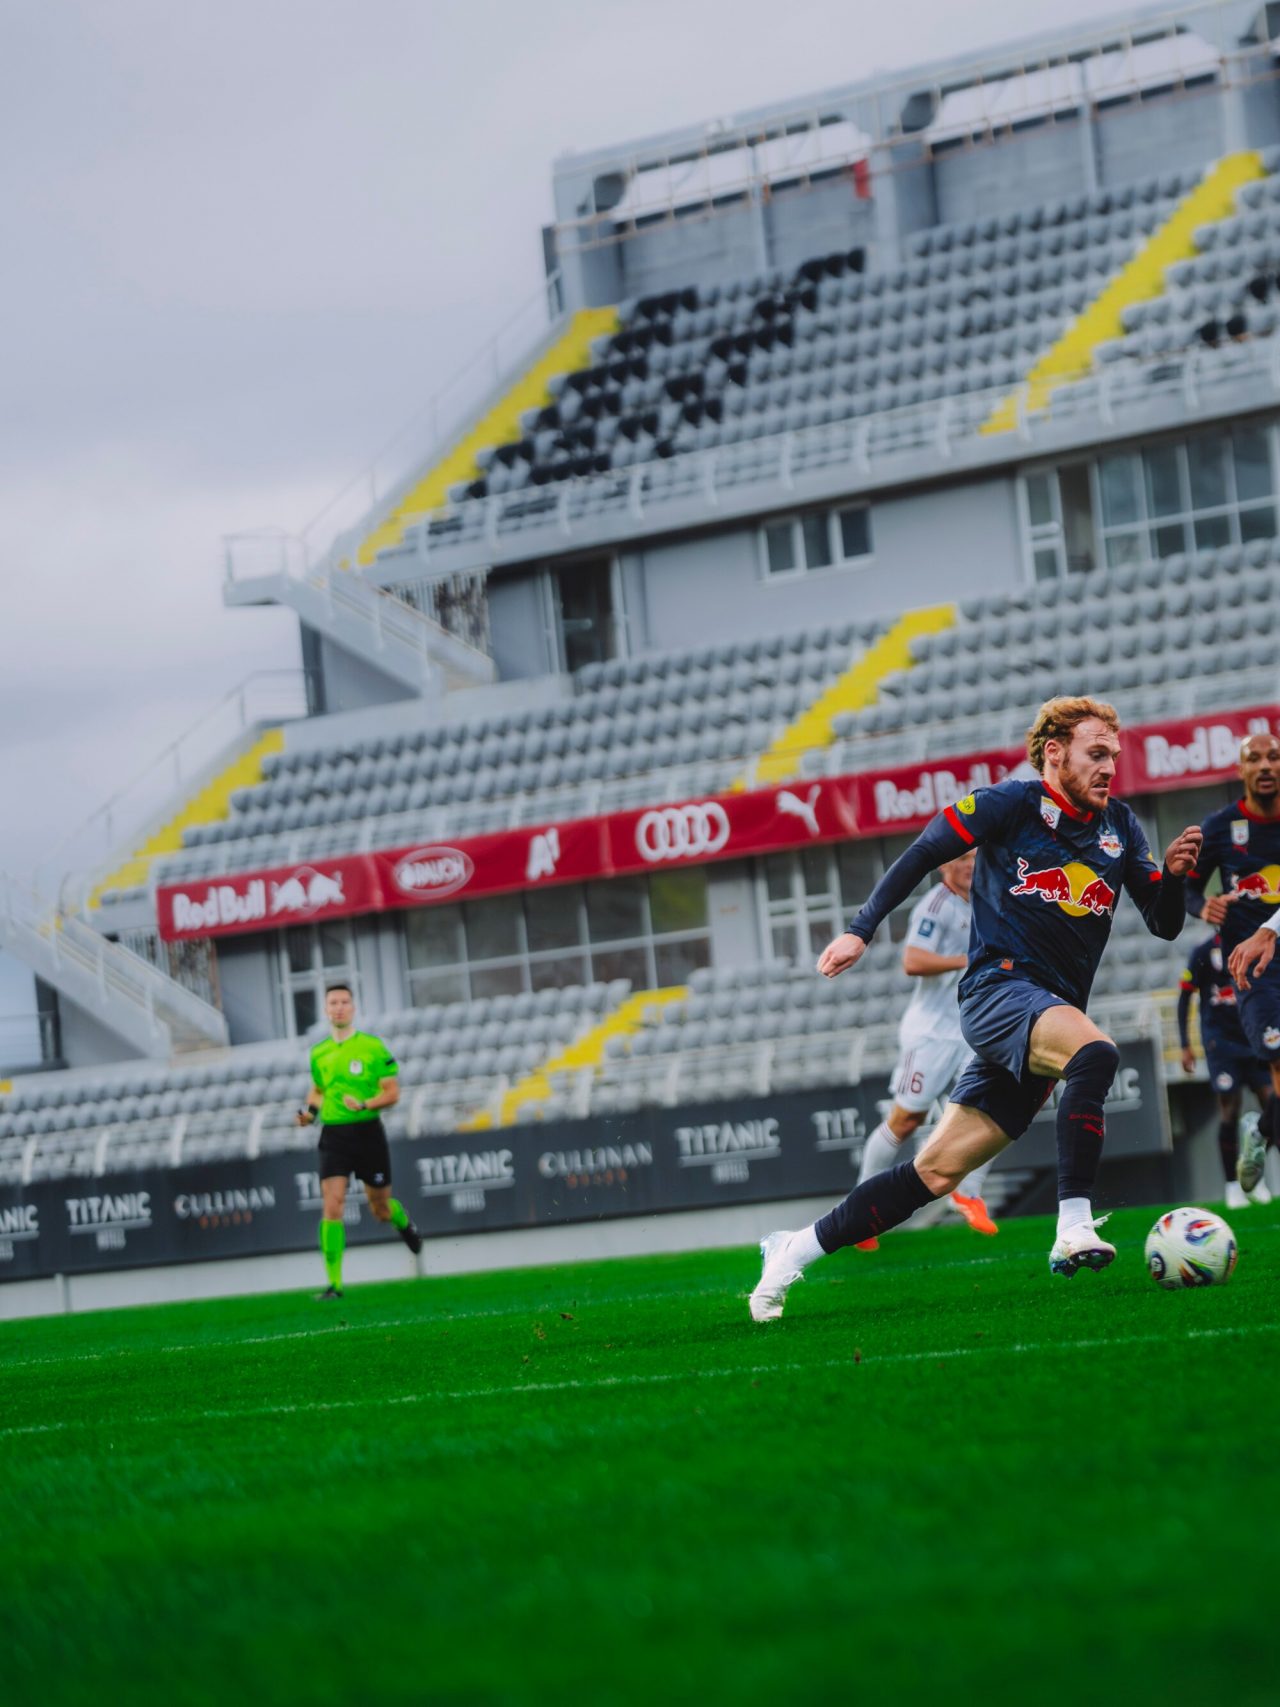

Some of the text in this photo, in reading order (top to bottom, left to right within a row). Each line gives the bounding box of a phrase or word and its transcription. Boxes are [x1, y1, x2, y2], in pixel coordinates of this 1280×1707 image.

[674, 1117, 780, 1156] TITANIC
[416, 1149, 514, 1187] TITANIC
[538, 1142, 653, 1178] CULLINAN
[66, 1191, 151, 1225] TITANIC
[174, 1186, 275, 1218] CULLINAN
